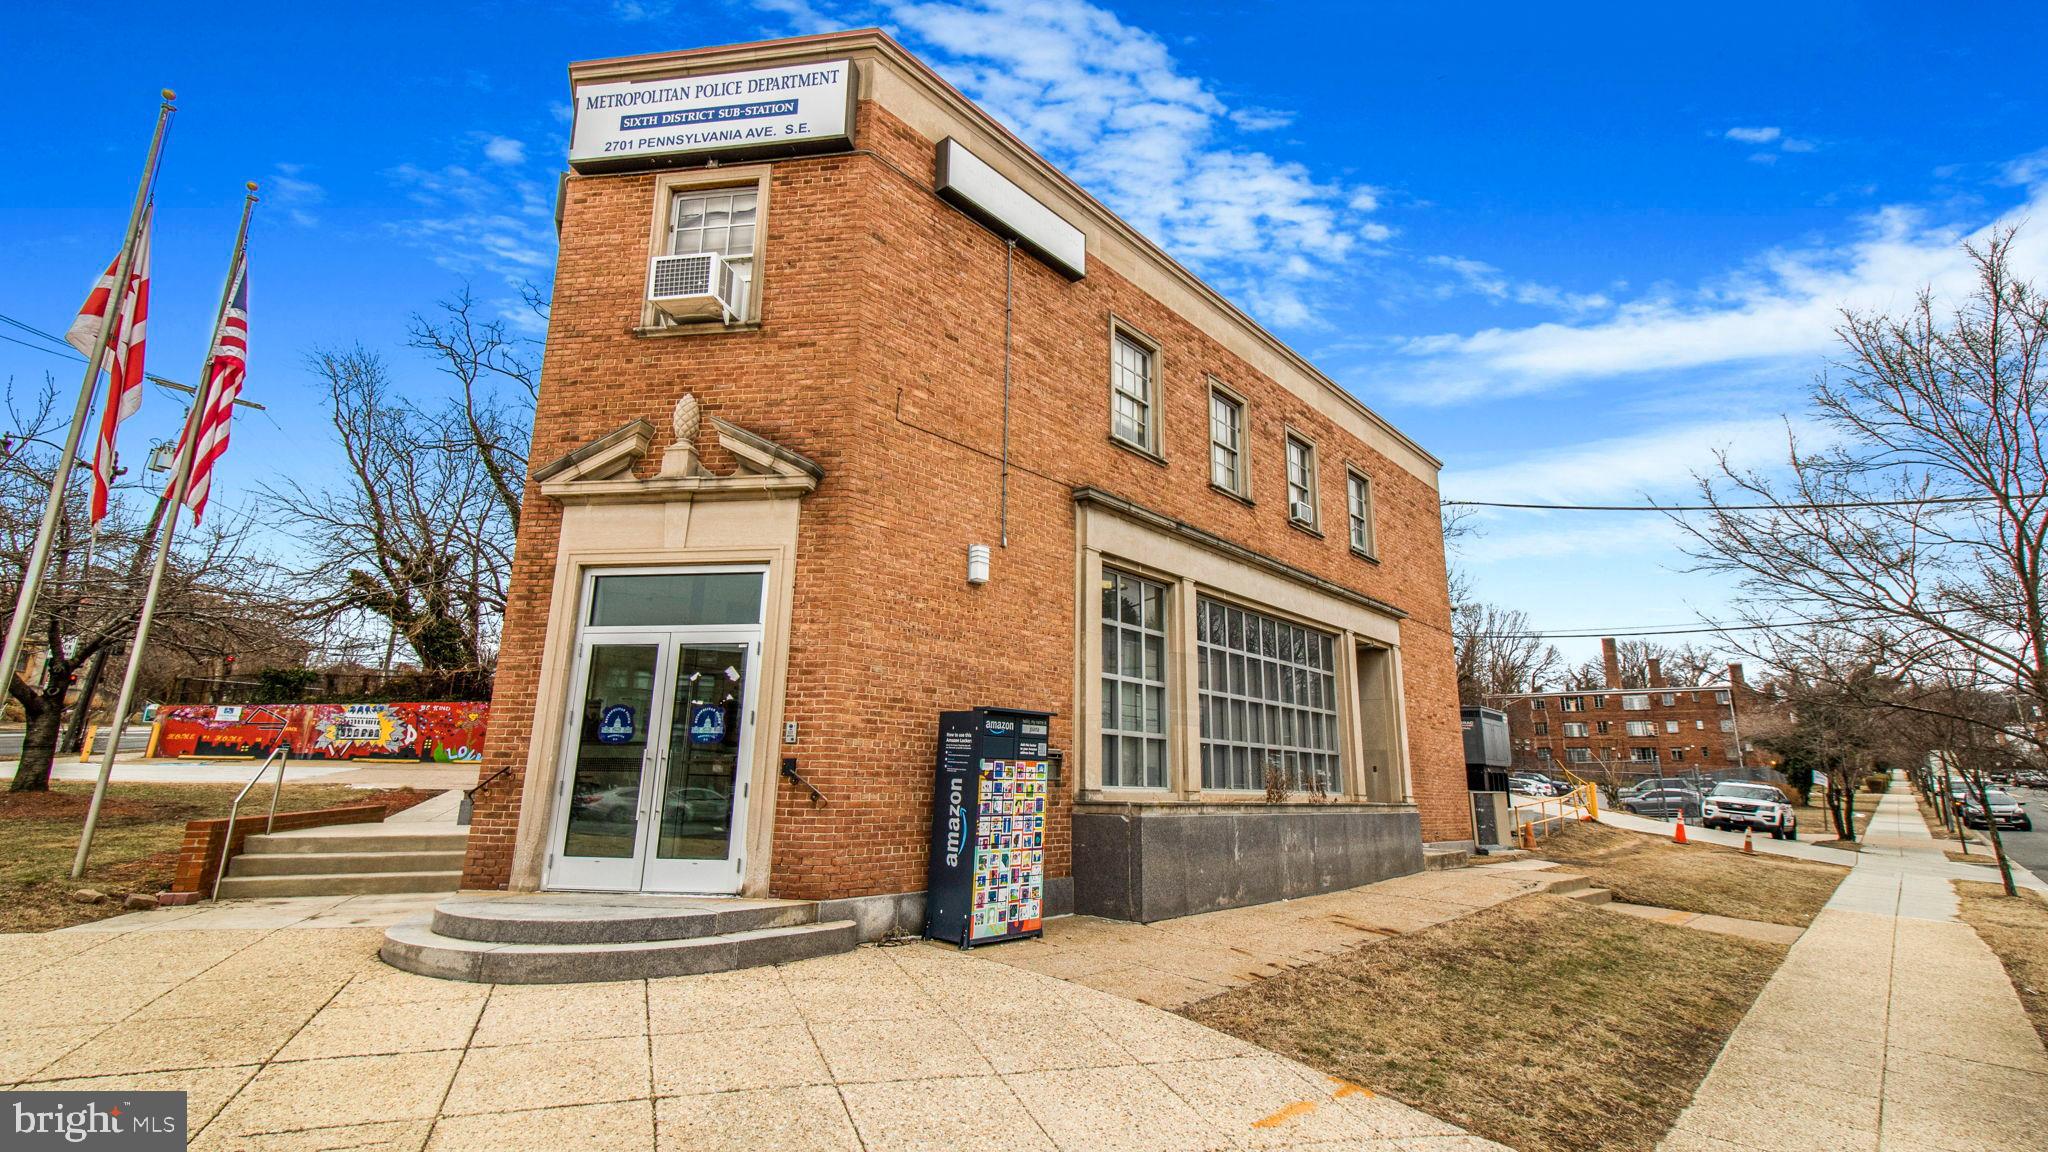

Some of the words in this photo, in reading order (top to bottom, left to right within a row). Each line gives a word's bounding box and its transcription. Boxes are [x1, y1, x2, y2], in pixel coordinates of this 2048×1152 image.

[586, 85, 690, 110] METROPOLITAN
[695, 80, 743, 99] POLICE
[747, 69, 840, 94] DEPARTMENT
[623, 115, 658, 128] SIXTH
[661, 110, 715, 125] DISTRICT
[718, 101, 794, 119] SUB-STATION
[604, 139, 633, 152] 2701
[638, 129, 742, 149] PENNSYLVANIA
[745, 126, 777, 138] AVE.
[784, 122, 811, 135] S.E.
[985, 720, 1015, 731] amazon
[946, 778, 963, 867] amazon
